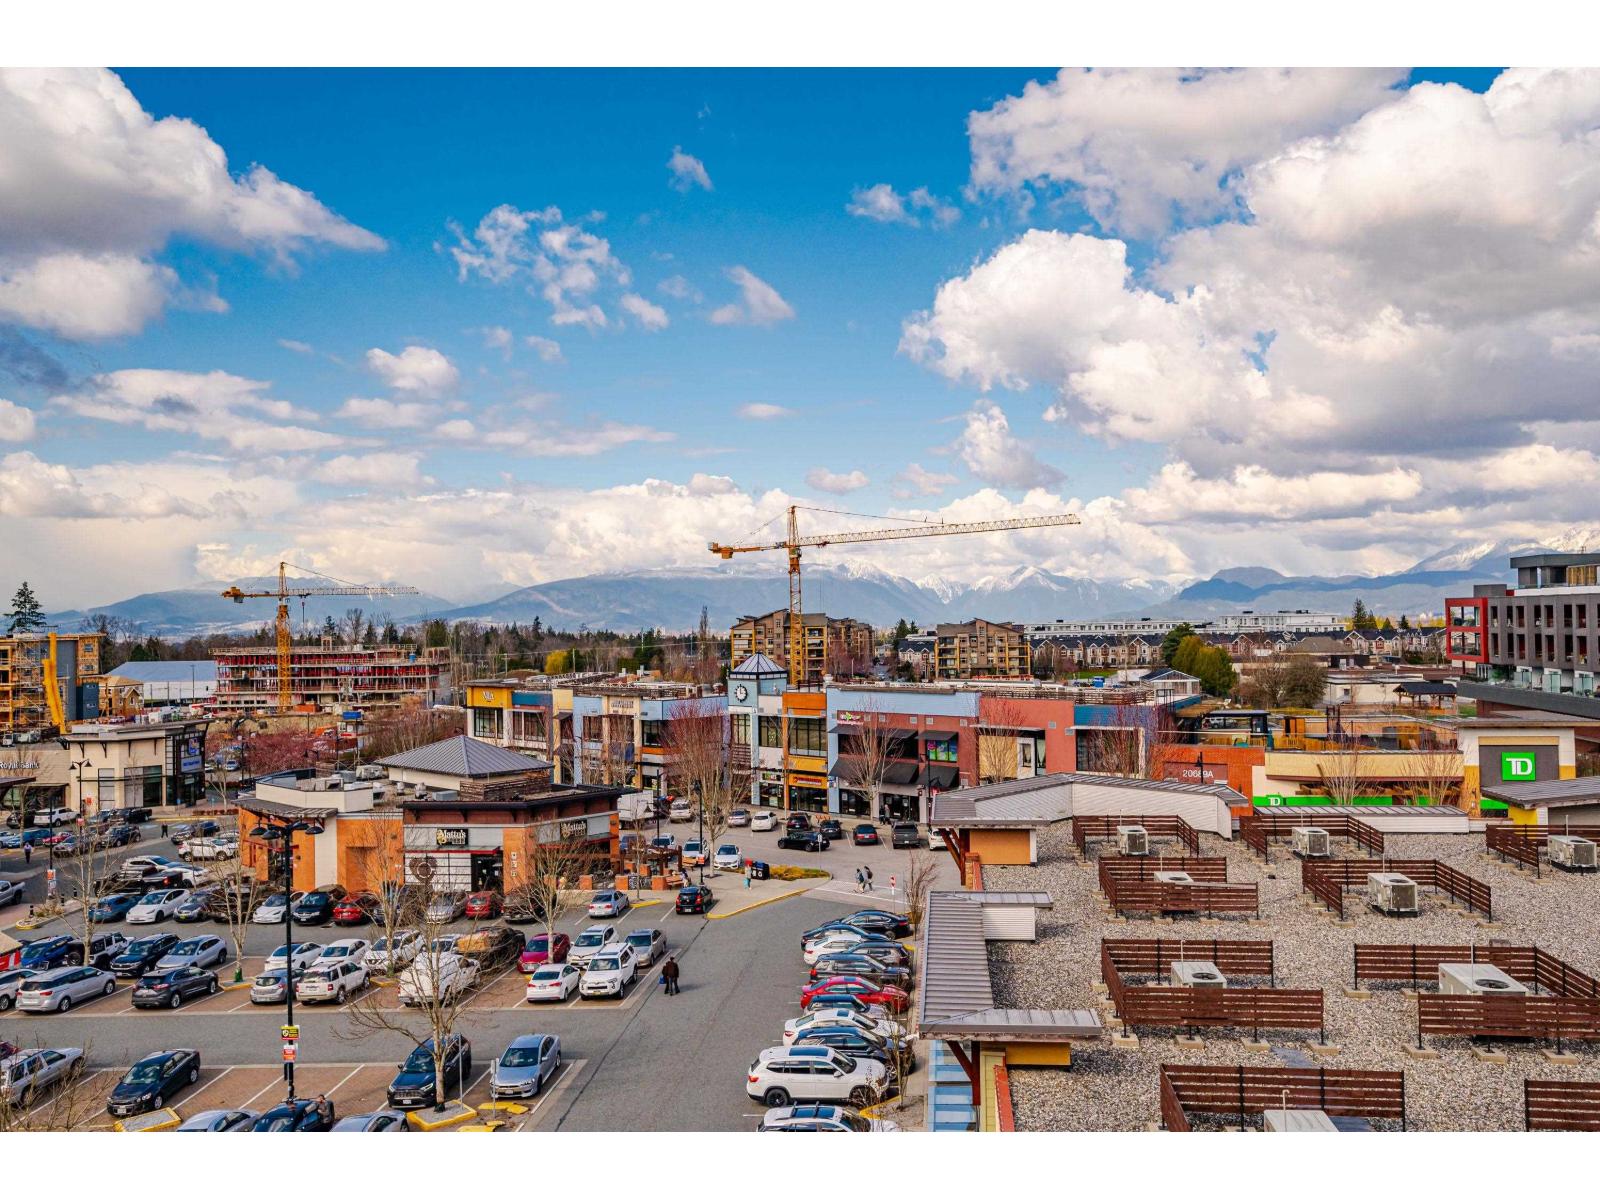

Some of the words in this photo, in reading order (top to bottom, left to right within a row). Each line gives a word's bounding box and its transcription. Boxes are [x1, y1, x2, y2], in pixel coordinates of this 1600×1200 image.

[1505, 758, 1533, 776] TD
[1267, 797, 1281, 806] TD
[437, 829, 466, 842] Mattu's
